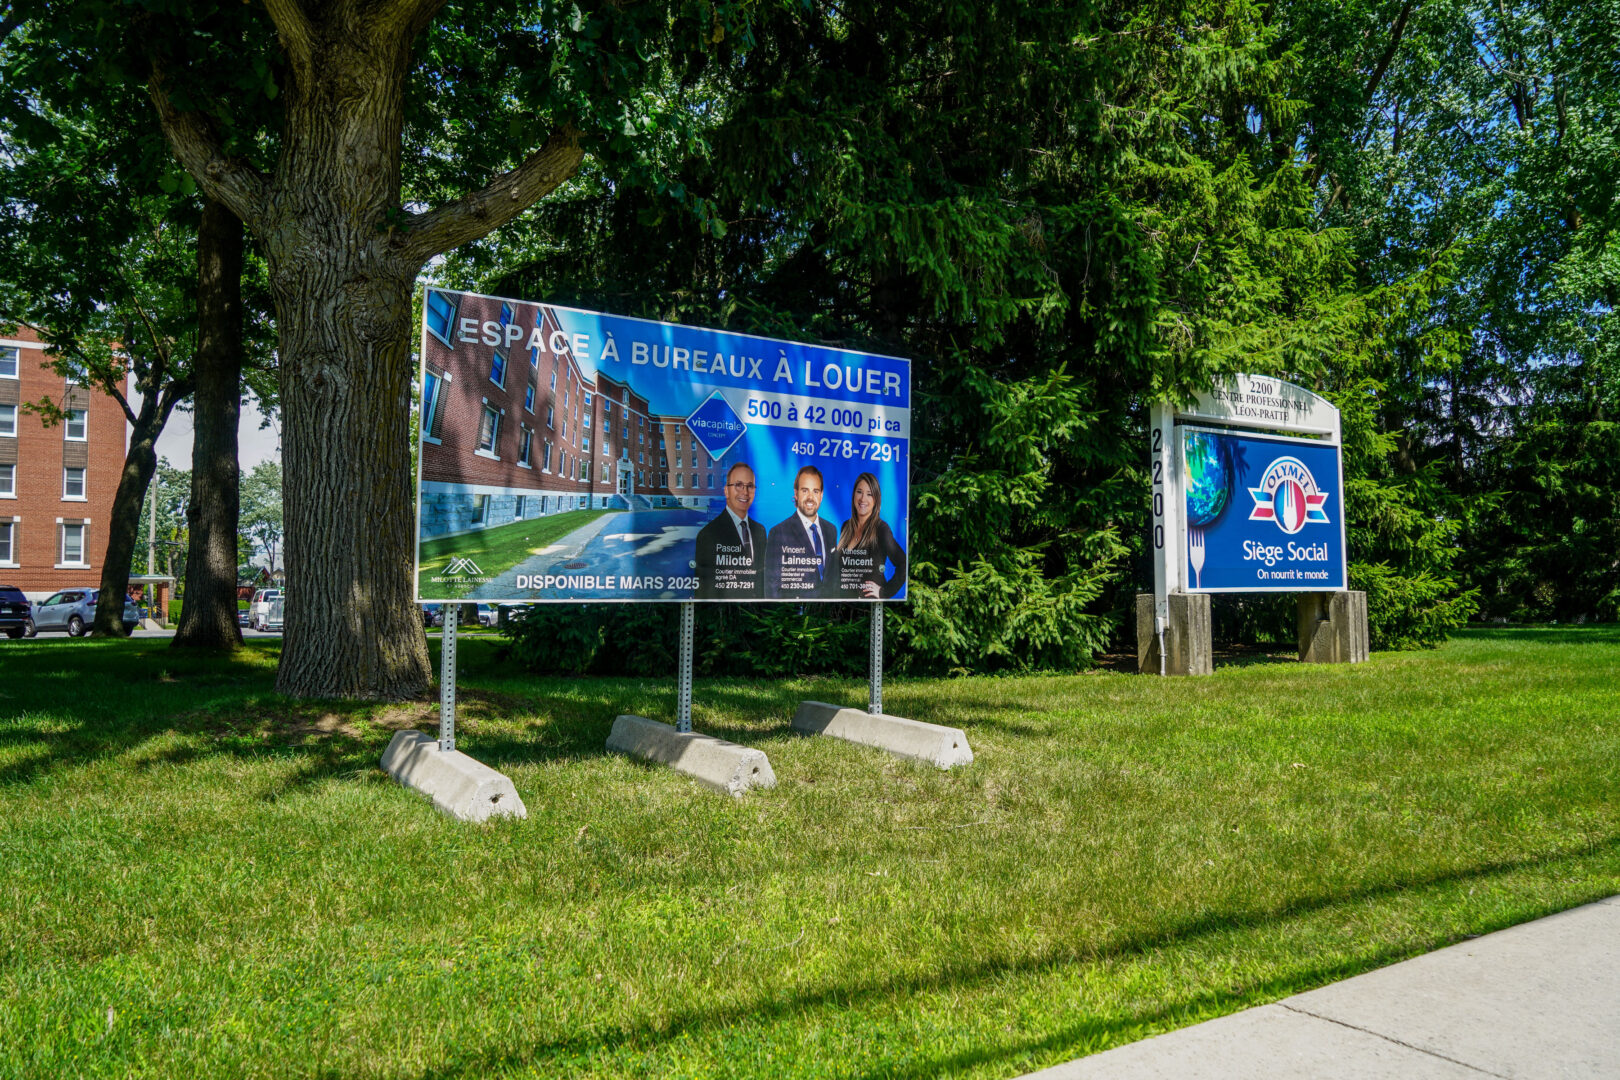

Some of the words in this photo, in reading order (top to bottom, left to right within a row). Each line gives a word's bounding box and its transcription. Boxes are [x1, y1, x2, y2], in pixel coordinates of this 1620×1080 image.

[459, 317, 590, 358] ESPACE
[600, 331, 620, 362] À
[631, 341, 763, 380] BUREAUX
[773, 349, 793, 384] À
[805, 360, 901, 397] LOUER
[1250, 380, 1273, 395] 2200
[1211, 389, 1245, 403] CENTRE
[1246, 394, 1308, 411] PROFESSIONNEL
[747, 399, 781, 420] 500
[787, 402, 798, 421] à
[804, 406, 826, 424] 42
[831, 408, 863, 428] 000
[868, 416, 881, 432] pi
[884, 420, 900, 432] ca
[1235, 405, 1289, 421] LÉON-PRATTE
[692, 417, 742, 432] viacapitale
[791, 441, 814, 456] 450
[819, 438, 900, 462] 278-7291
[1267, 464, 1311, 493] OLYMEL
[1152, 428, 1164, 550] 2200
[716, 543, 742, 552] Pascal
[781, 545, 806, 554] Vincent
[1243, 540, 1283, 566] Siège
[1287, 541, 1329, 561] Social
[716, 554, 752, 566] Milotte
[781, 555, 822, 565] Lainesse
[841, 556, 873, 566] Vincent
[1257, 568, 1269, 579] On
[1271, 569, 1295, 579] nourrit
[1296, 569, 1303, 579] le
[1304, 569, 1329, 579] monde
[516, 575, 615, 590] DISPONIBLE
[619, 575, 664, 590] MARS
[667, 576, 700, 590] 2025
[726, 581, 755, 589] 278-7291
